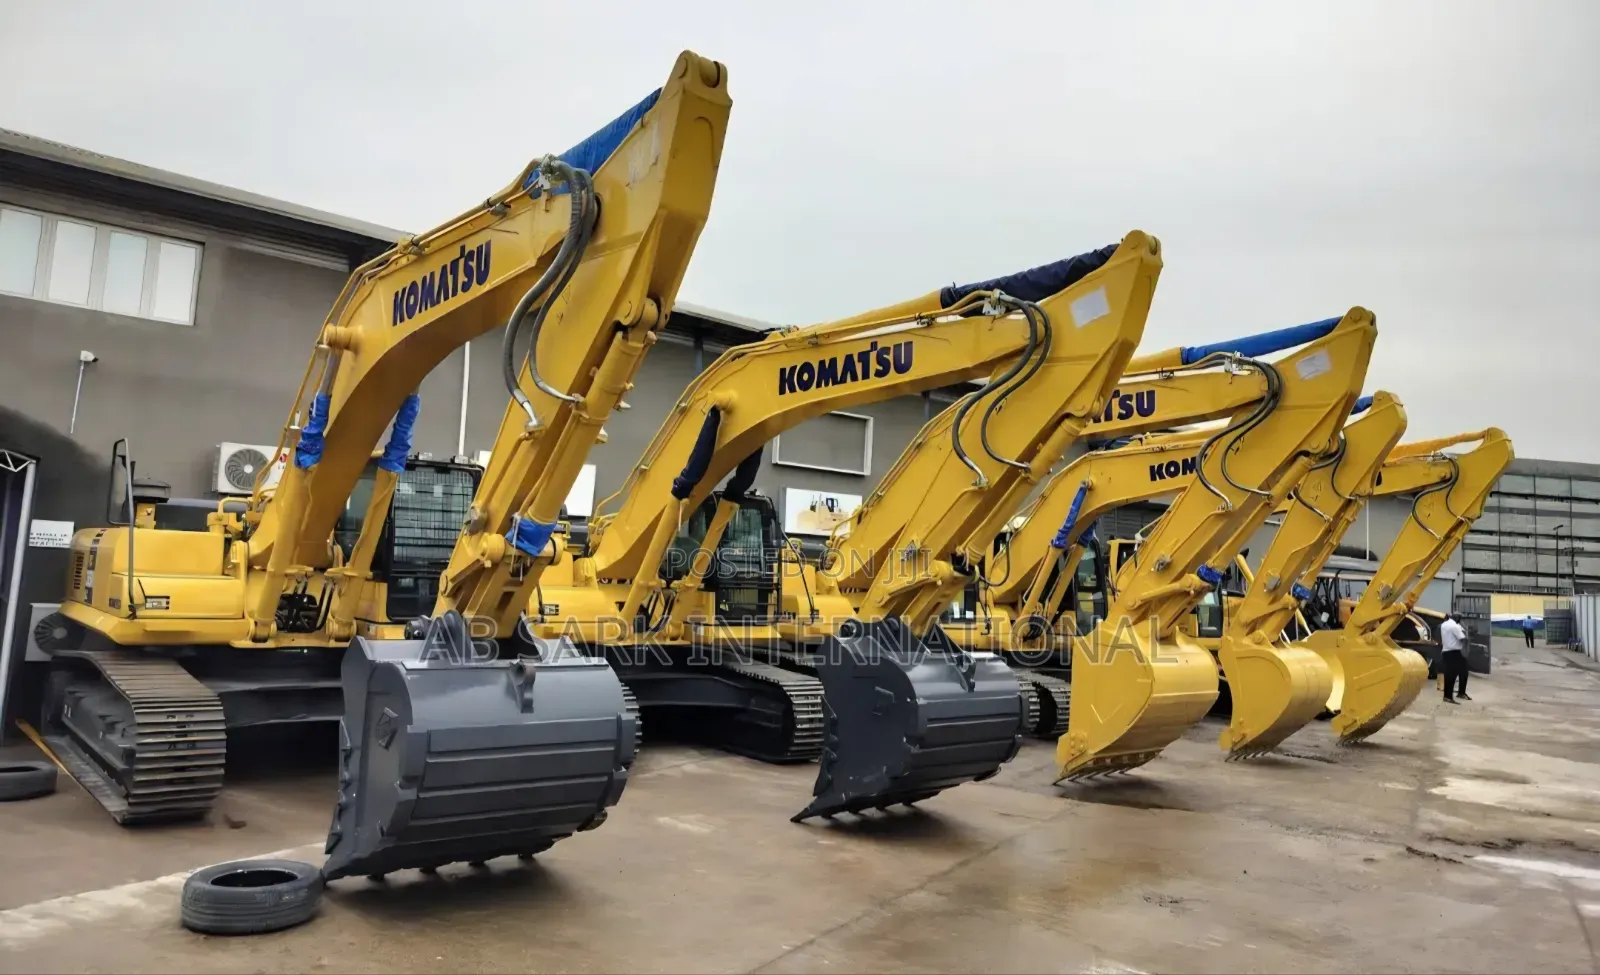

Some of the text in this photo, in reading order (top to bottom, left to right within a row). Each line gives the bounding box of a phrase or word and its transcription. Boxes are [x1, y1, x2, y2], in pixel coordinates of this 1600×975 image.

[392, 239, 492, 327] KOMATSU
[778, 340, 914, 396] KOMATSU
[1093, 389, 1156, 424] TSU
[1149, 456, 1199, 482] KOM
